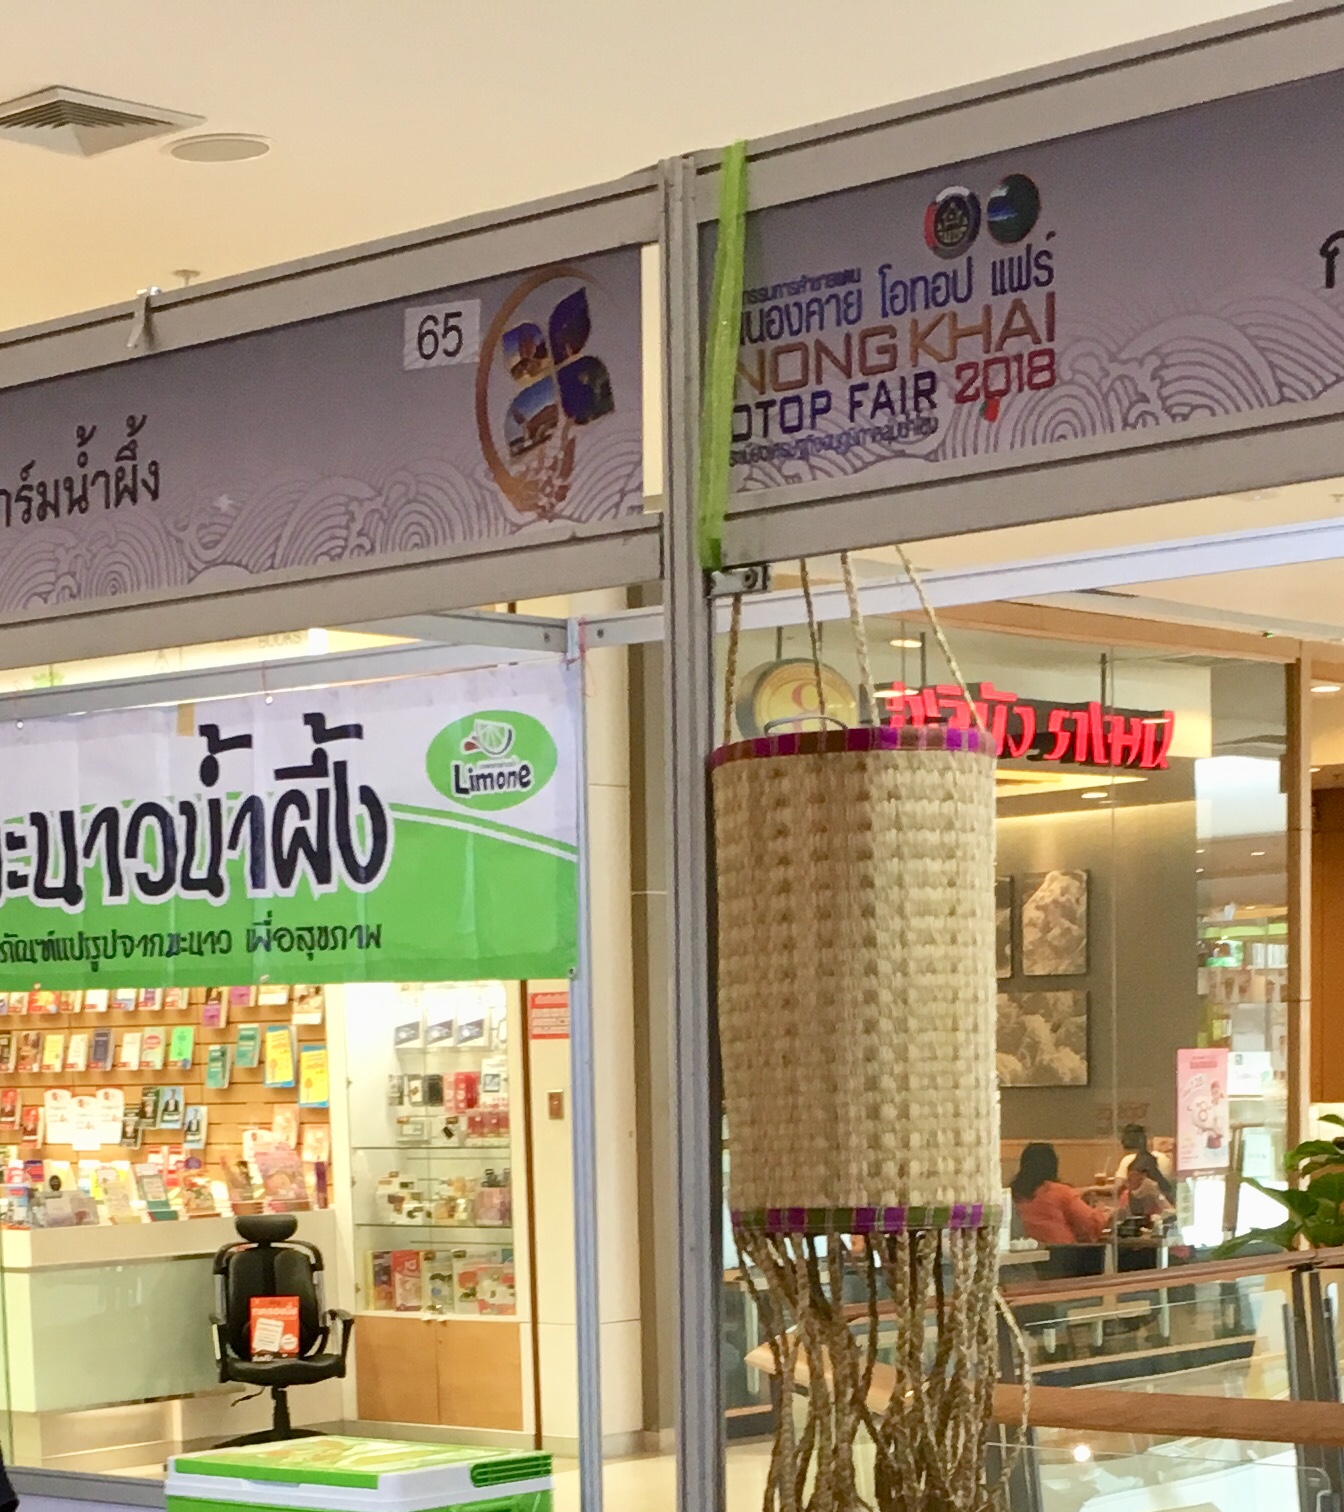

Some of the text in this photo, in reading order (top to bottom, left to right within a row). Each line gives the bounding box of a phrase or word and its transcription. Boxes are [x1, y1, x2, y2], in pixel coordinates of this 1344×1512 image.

[878, 262, 973, 318] โอทอป
[992, 231, 1056, 295] แฟร์
[417, 311, 463, 361] 65
[910, 291, 1056, 368] KHAI
[849, 370, 938, 422] FAIR
[955, 348, 1056, 405] 2018
[454, 763, 532, 794] Limone
[245, 910, 383, 961] เพื่อสุขภาพ
